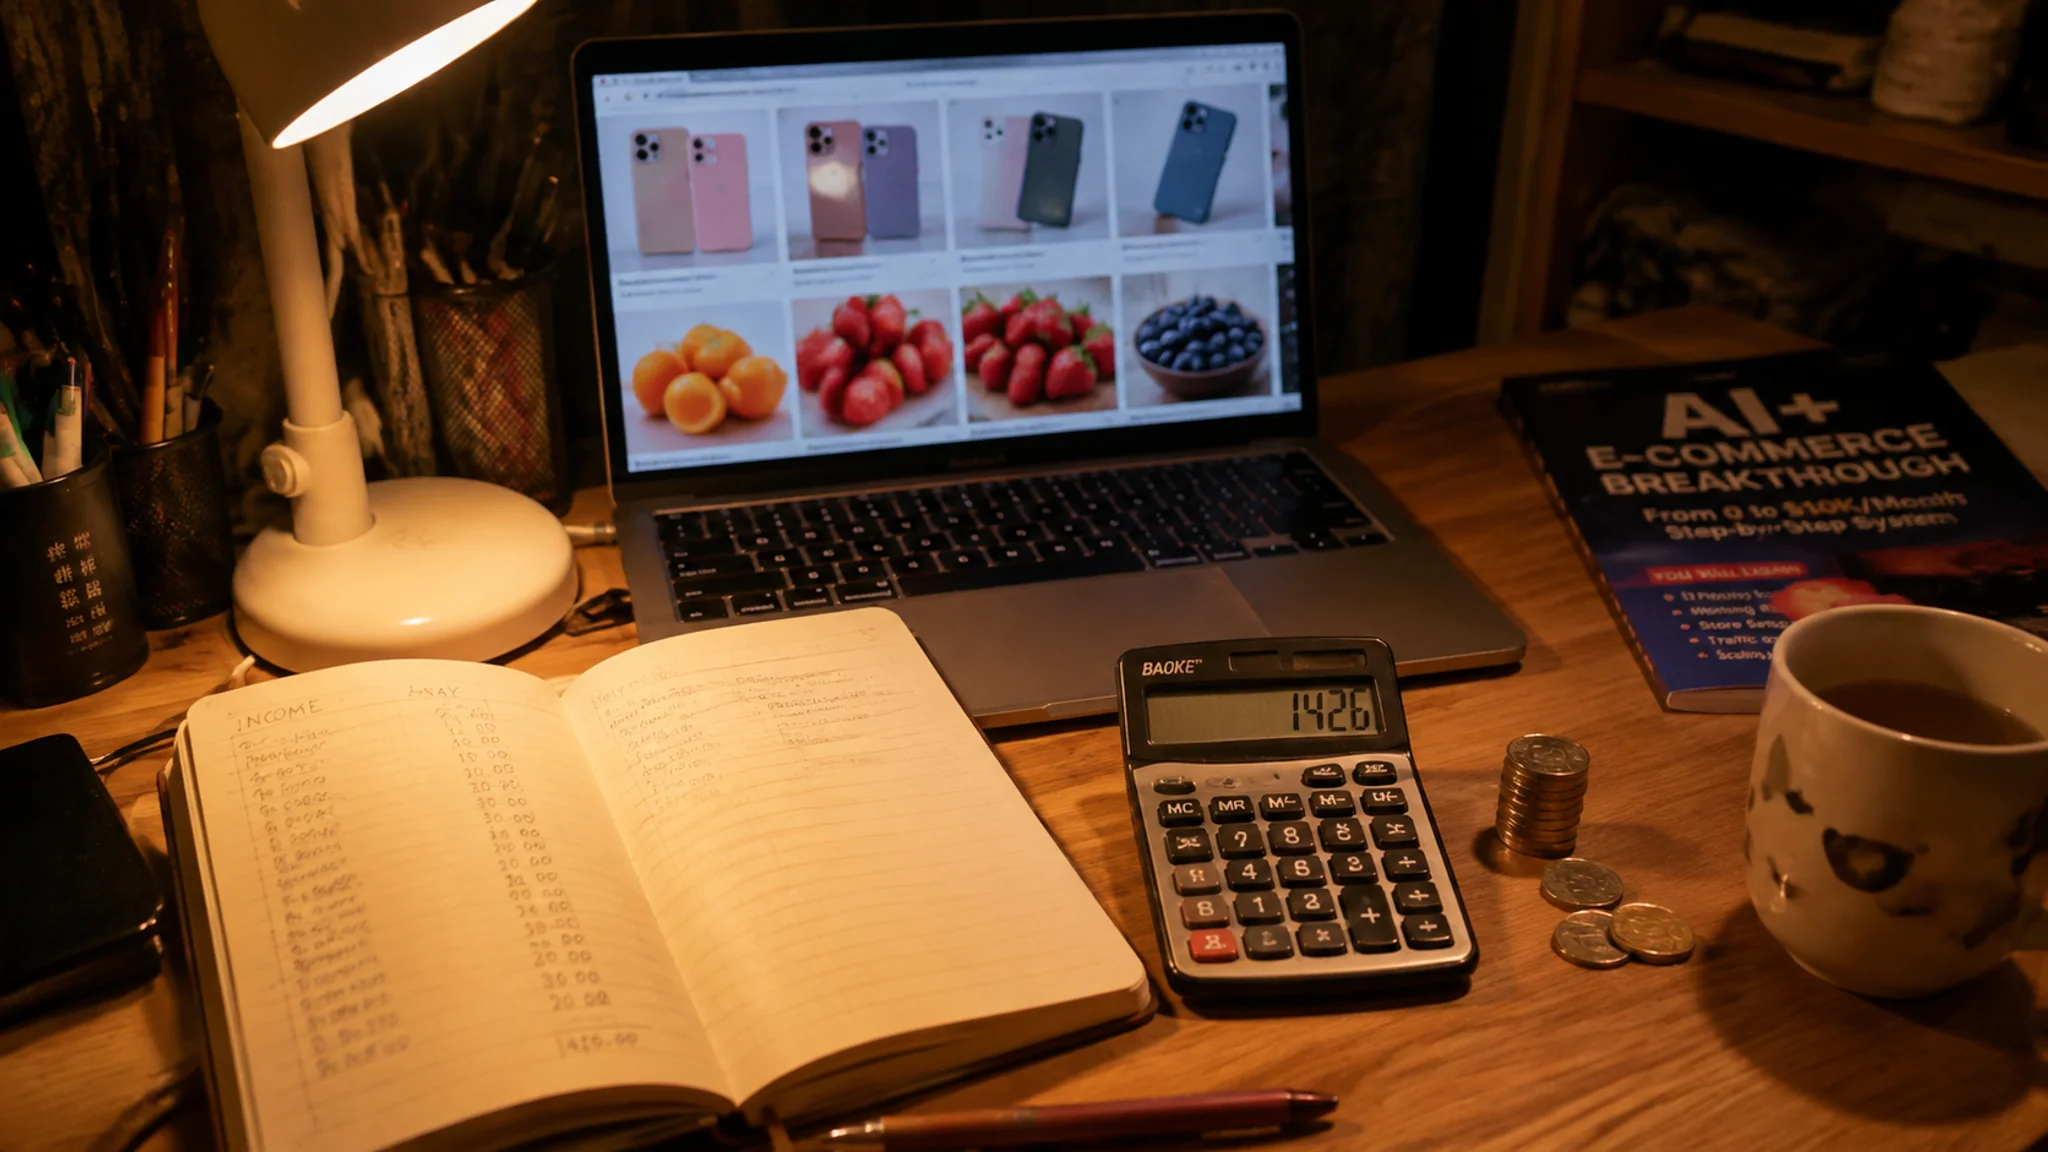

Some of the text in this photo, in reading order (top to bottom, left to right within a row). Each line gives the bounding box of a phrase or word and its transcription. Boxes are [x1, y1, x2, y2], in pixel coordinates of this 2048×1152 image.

[1662, 386, 1840, 439] AI+
[1585, 422, 1949, 470] E-COMMERCE
[1600, 452, 1972, 495] BREAKTHROUGH
[1642, 506, 1718, 523] From
[1748, 503, 1778, 519] to
[1142, 659, 1196, 676] BAOKE
[237, 699, 323, 732] INCOME
[1291, 688, 1370, 732] 1426
[1167, 802, 1194, 814] MC
[1218, 799, 1246, 811] MR
[1283, 827, 1300, 844] 8
[1241, 863, 1257, 880] 4
[1252, 896, 1265, 913] 1
[1303, 894, 1320, 909] 2
